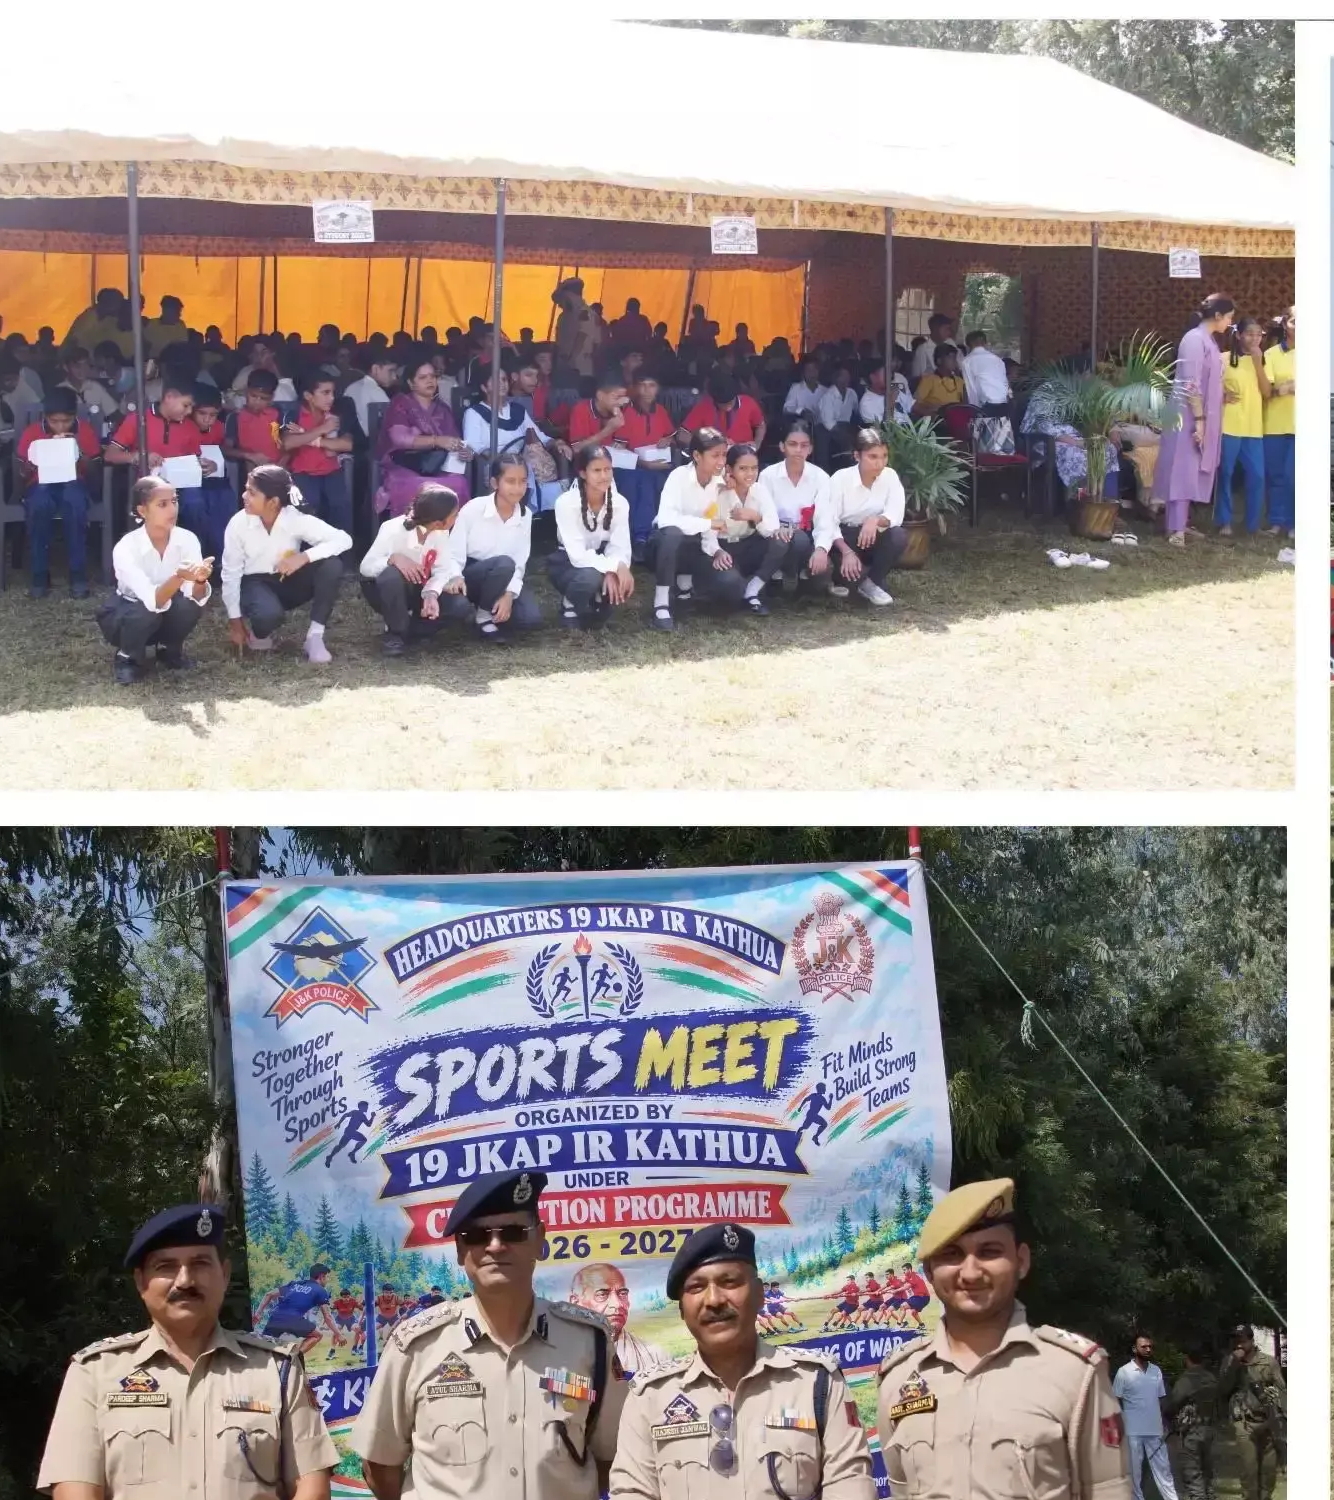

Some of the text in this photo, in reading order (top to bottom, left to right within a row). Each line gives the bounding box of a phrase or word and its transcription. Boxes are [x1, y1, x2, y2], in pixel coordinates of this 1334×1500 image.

[393, 906, 779, 977] HEADQUARTERS 19 JKAP IR KATHUA
[813, 935, 856, 963] J&K
[818, 973, 852, 984] POLICE
[294, 987, 349, 1008] J&K POLICE
[252, 1030, 334, 1078] Stronger
[821, 1032, 893, 1079] Fit Minds
[261, 1051, 343, 1099] Together
[390, 1018, 800, 1130] SPORTS MEET
[833, 1050, 916, 1102] Build Strong
[270, 1071, 343, 1122] Through
[863, 1077, 911, 1112] Teams
[284, 1096, 348, 1143] Sports
[515, 1104, 674, 1128] ORGANIZED BY
[405, 1128, 787, 1188] 19 JKAP IR KATHUA
[564, 1171, 629, 1189] UNDER
[615, 1190, 772, 1223] PROGRAMME
[620, 1228, 694, 1256] 2027
[844, 1339, 866, 1362] OF
[430, 1383, 478, 1394] ATUL SHARMA
